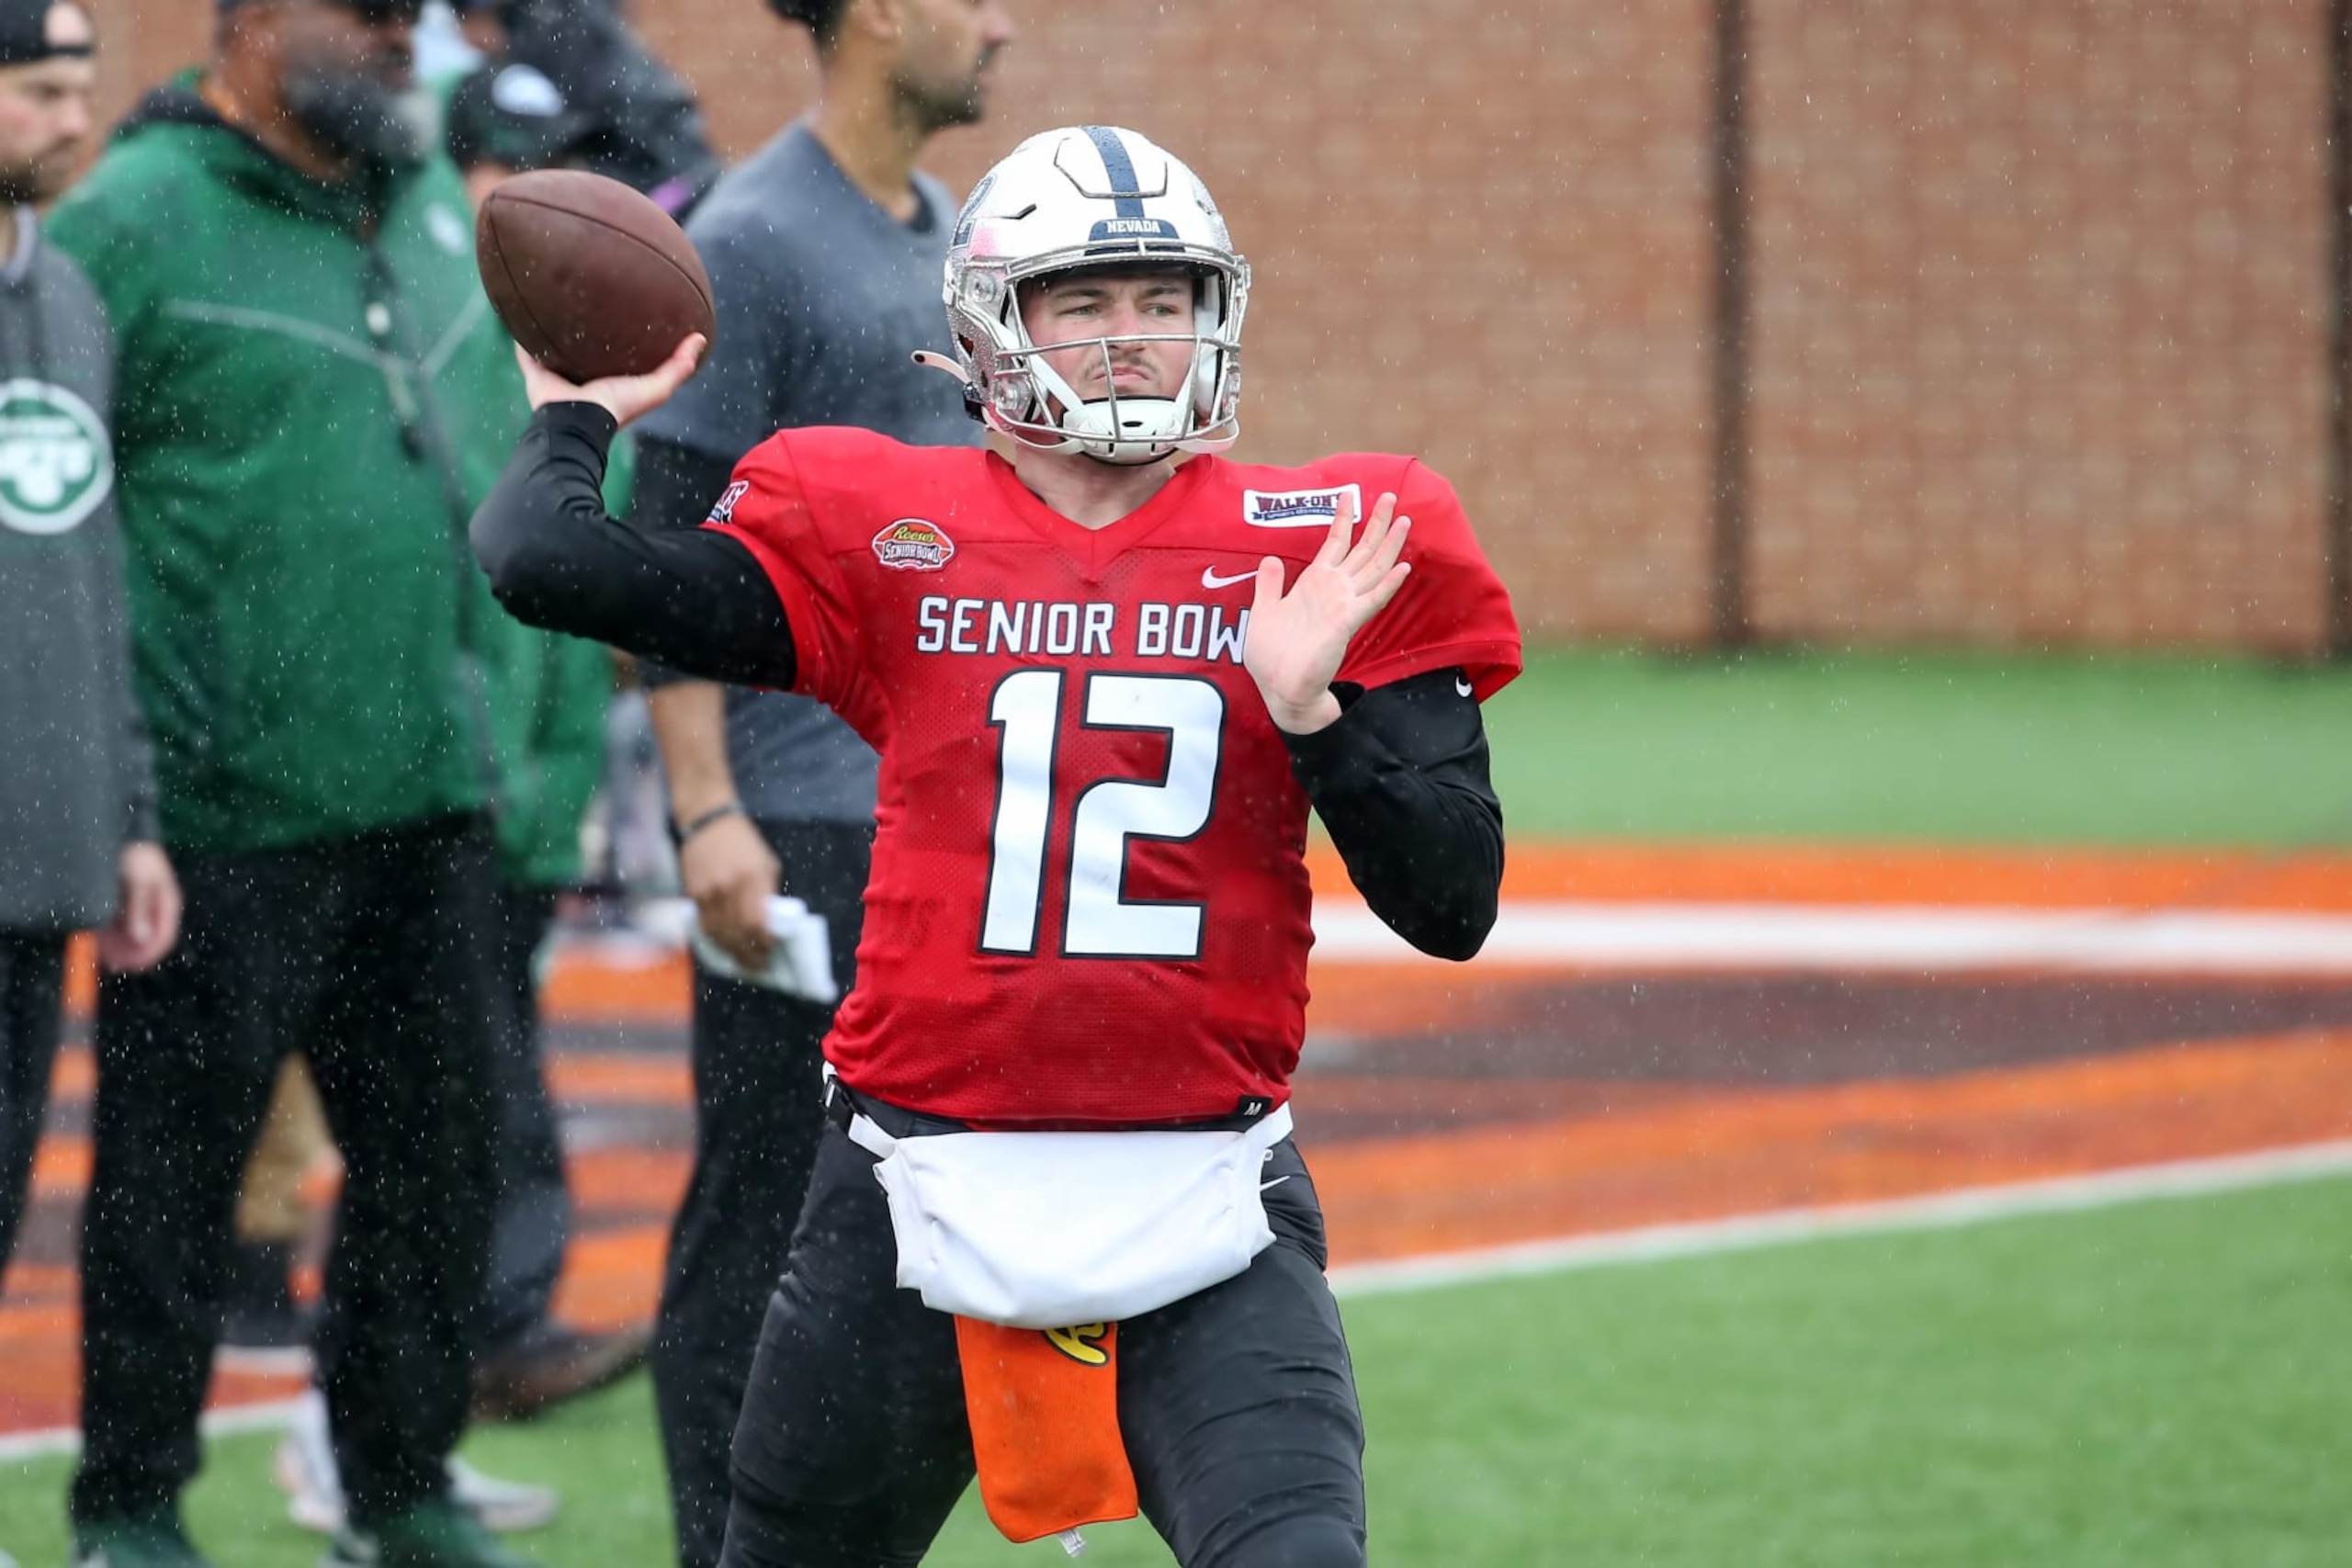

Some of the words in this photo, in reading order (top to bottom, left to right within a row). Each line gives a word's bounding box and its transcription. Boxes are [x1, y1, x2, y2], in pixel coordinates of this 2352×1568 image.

[1106, 220, 1161, 234] NEVADA
[884, 542, 916, 559] SENIOR
[916, 544, 939, 564] BOWL
[916, 595, 1115, 656] SENIOR
[1136, 602, 1250, 664] BOW
[978, 666, 1228, 964] 12
